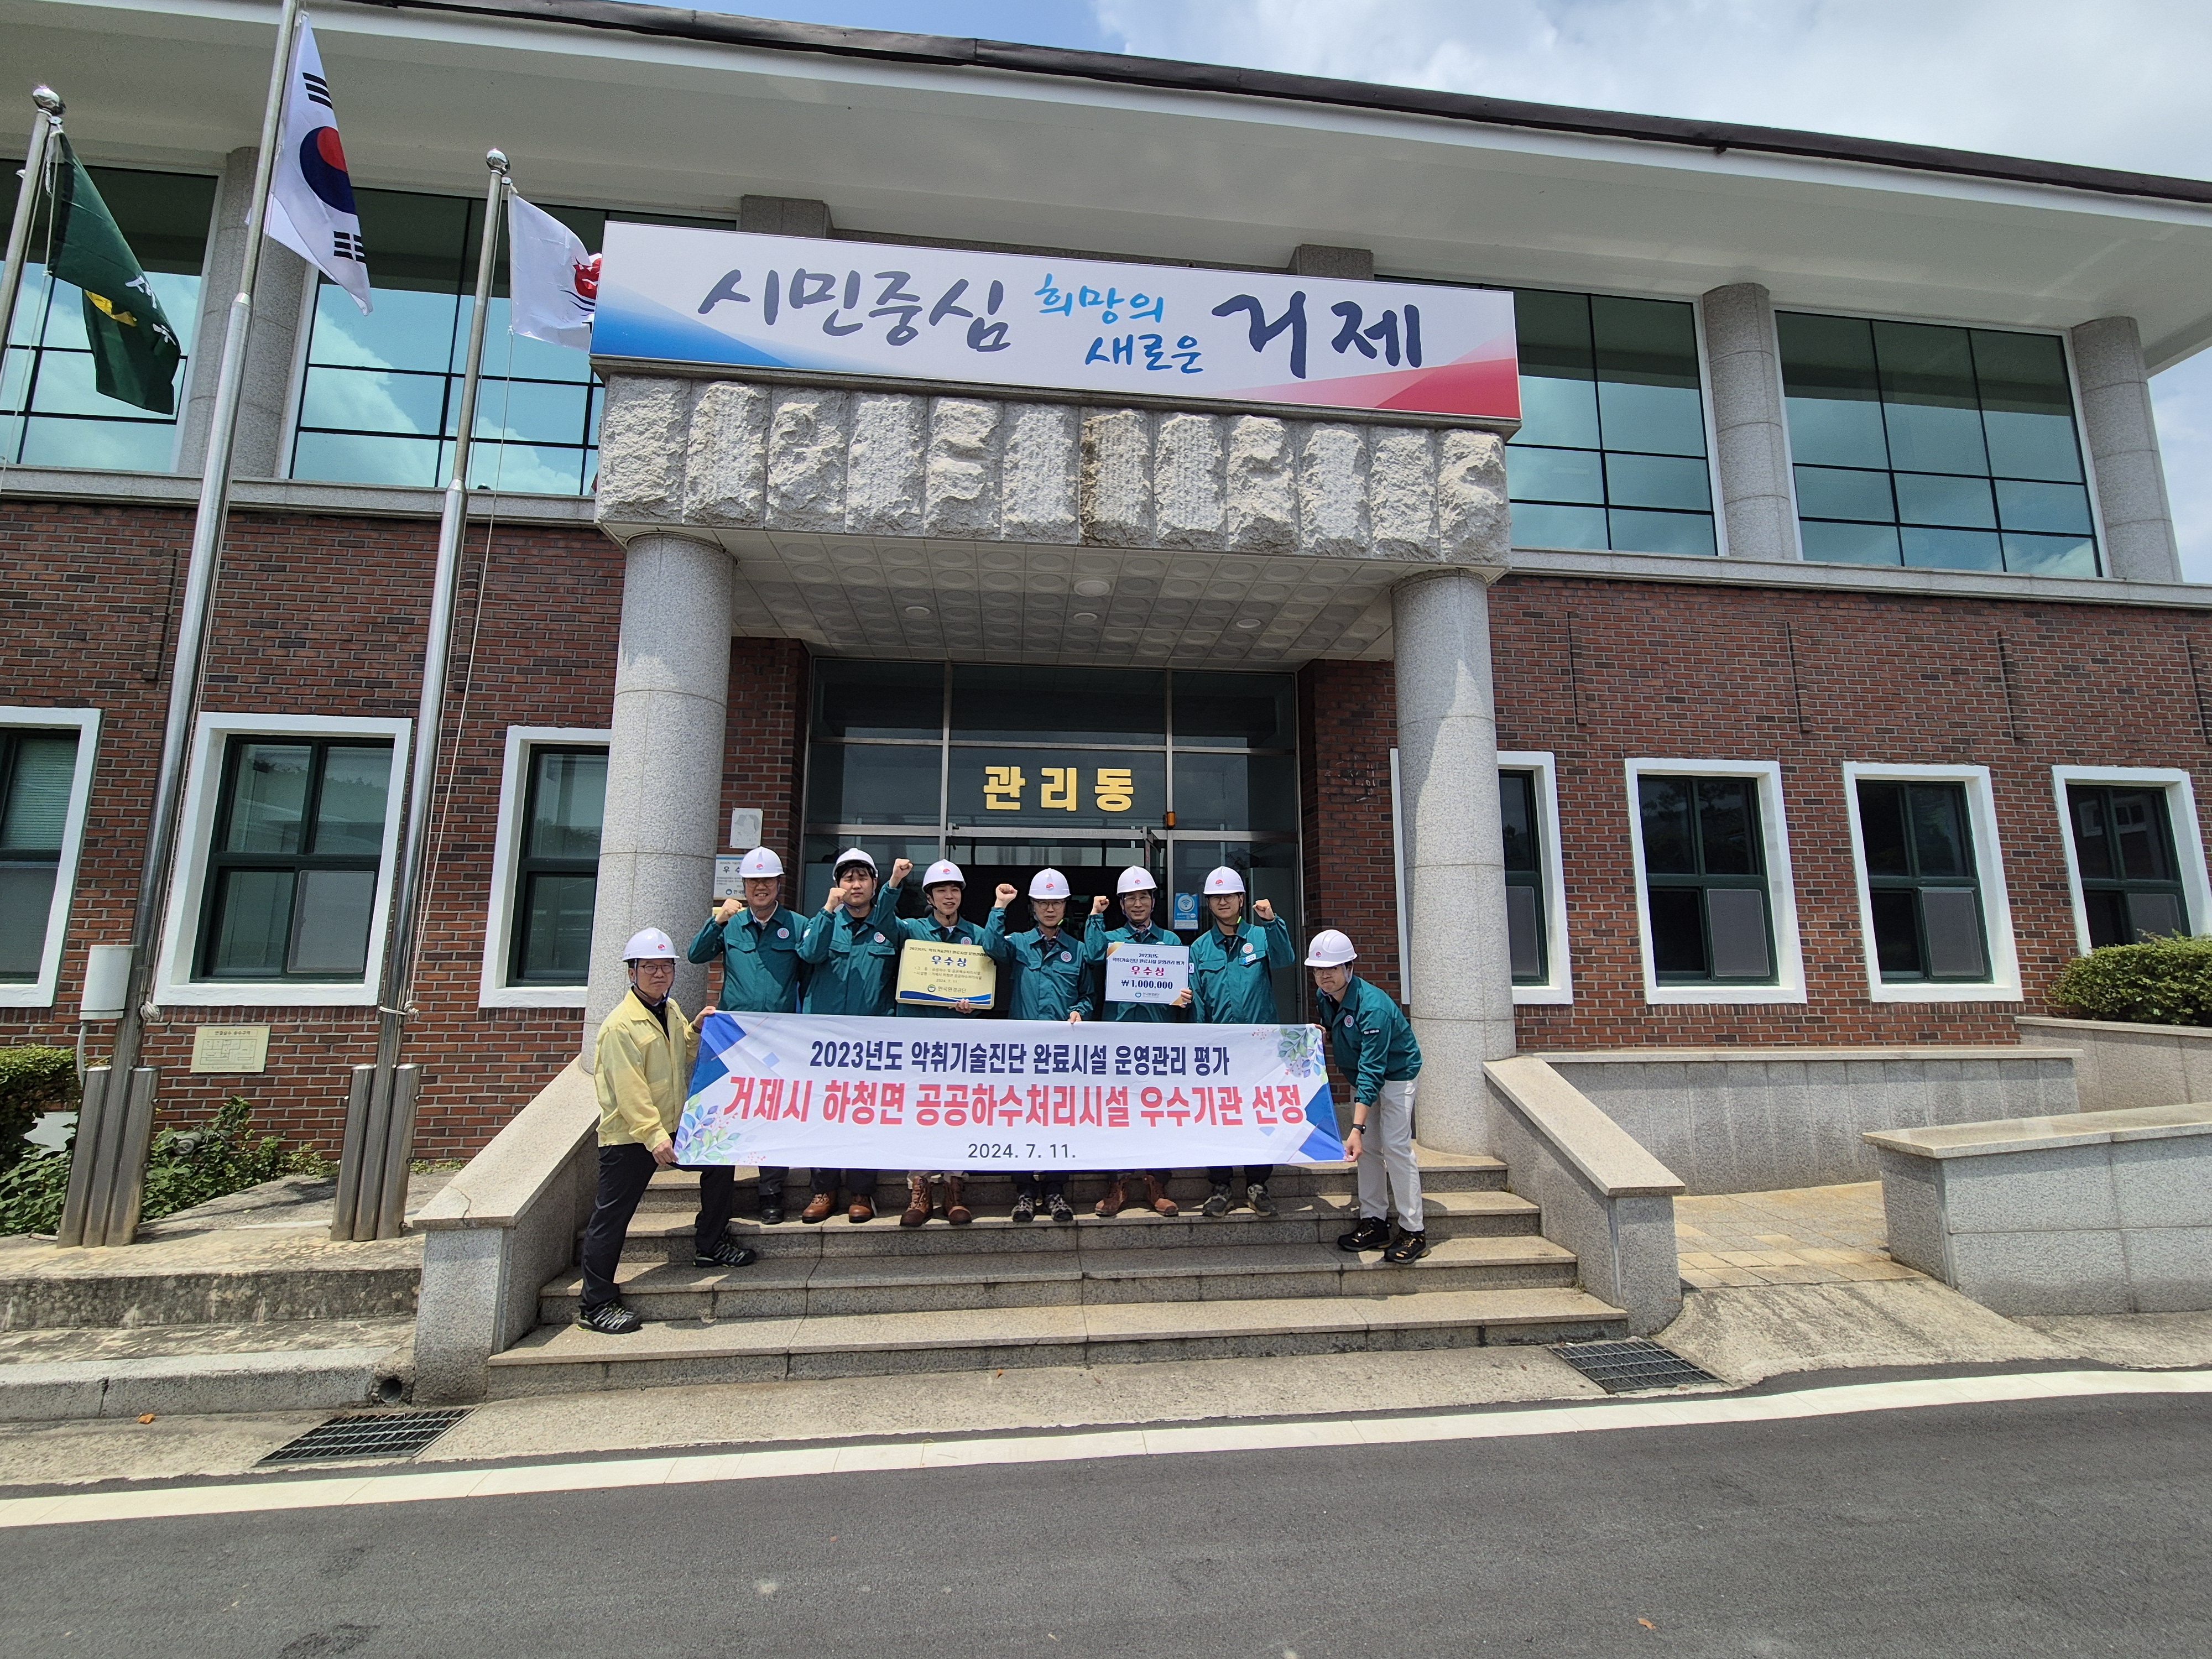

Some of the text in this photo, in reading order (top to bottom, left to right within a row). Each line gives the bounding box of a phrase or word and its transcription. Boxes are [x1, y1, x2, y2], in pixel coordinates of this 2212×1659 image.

[698, 269, 1012, 352] 시민중심
[1035, 273, 1165, 324] 희망의
[1085, 333, 1204, 374] 새로운
[1211, 291, 1422, 379] 거제
[983, 766, 1134, 812] 관리동
[931, 955, 967, 967] 우수상
[1131, 966, 1165, 977] 우수상
[810, 1040, 1230, 1076] 2023년도 악취기술진단 완료시설 운영관리 평가
[723, 1076, 1304, 1128] 거제시 하청면 공공하수처리시설 우수기관 선정
[968, 1143, 1076, 1159] 2024. 7. 11.
